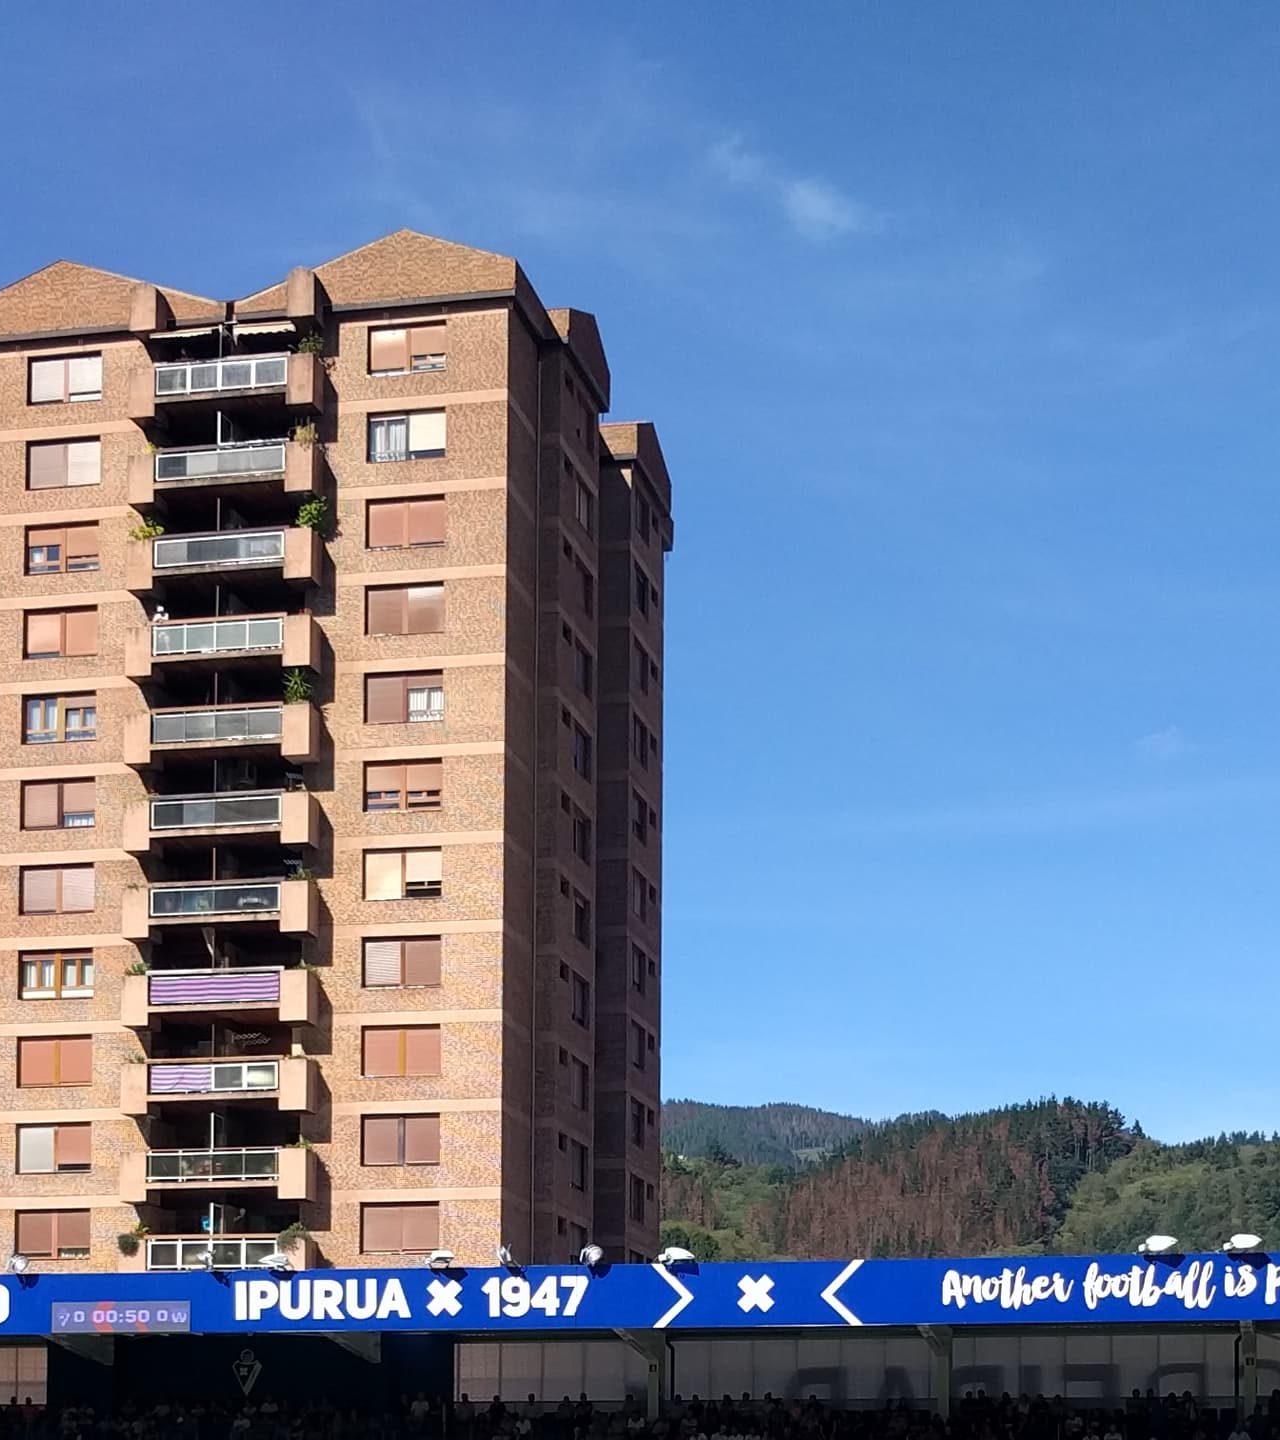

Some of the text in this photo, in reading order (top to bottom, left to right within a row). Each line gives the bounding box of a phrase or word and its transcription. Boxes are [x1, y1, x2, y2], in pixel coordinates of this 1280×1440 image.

[234, 1278, 411, 1321] IPURUA
[481, 1276, 589, 1317] 1947
[941, 1266, 1074, 1310] Another
[1082, 1260, 1216, 1309] football
[1224, 1264, 1257, 1297] is
[92, 1310, 150, 1324] 00:50
